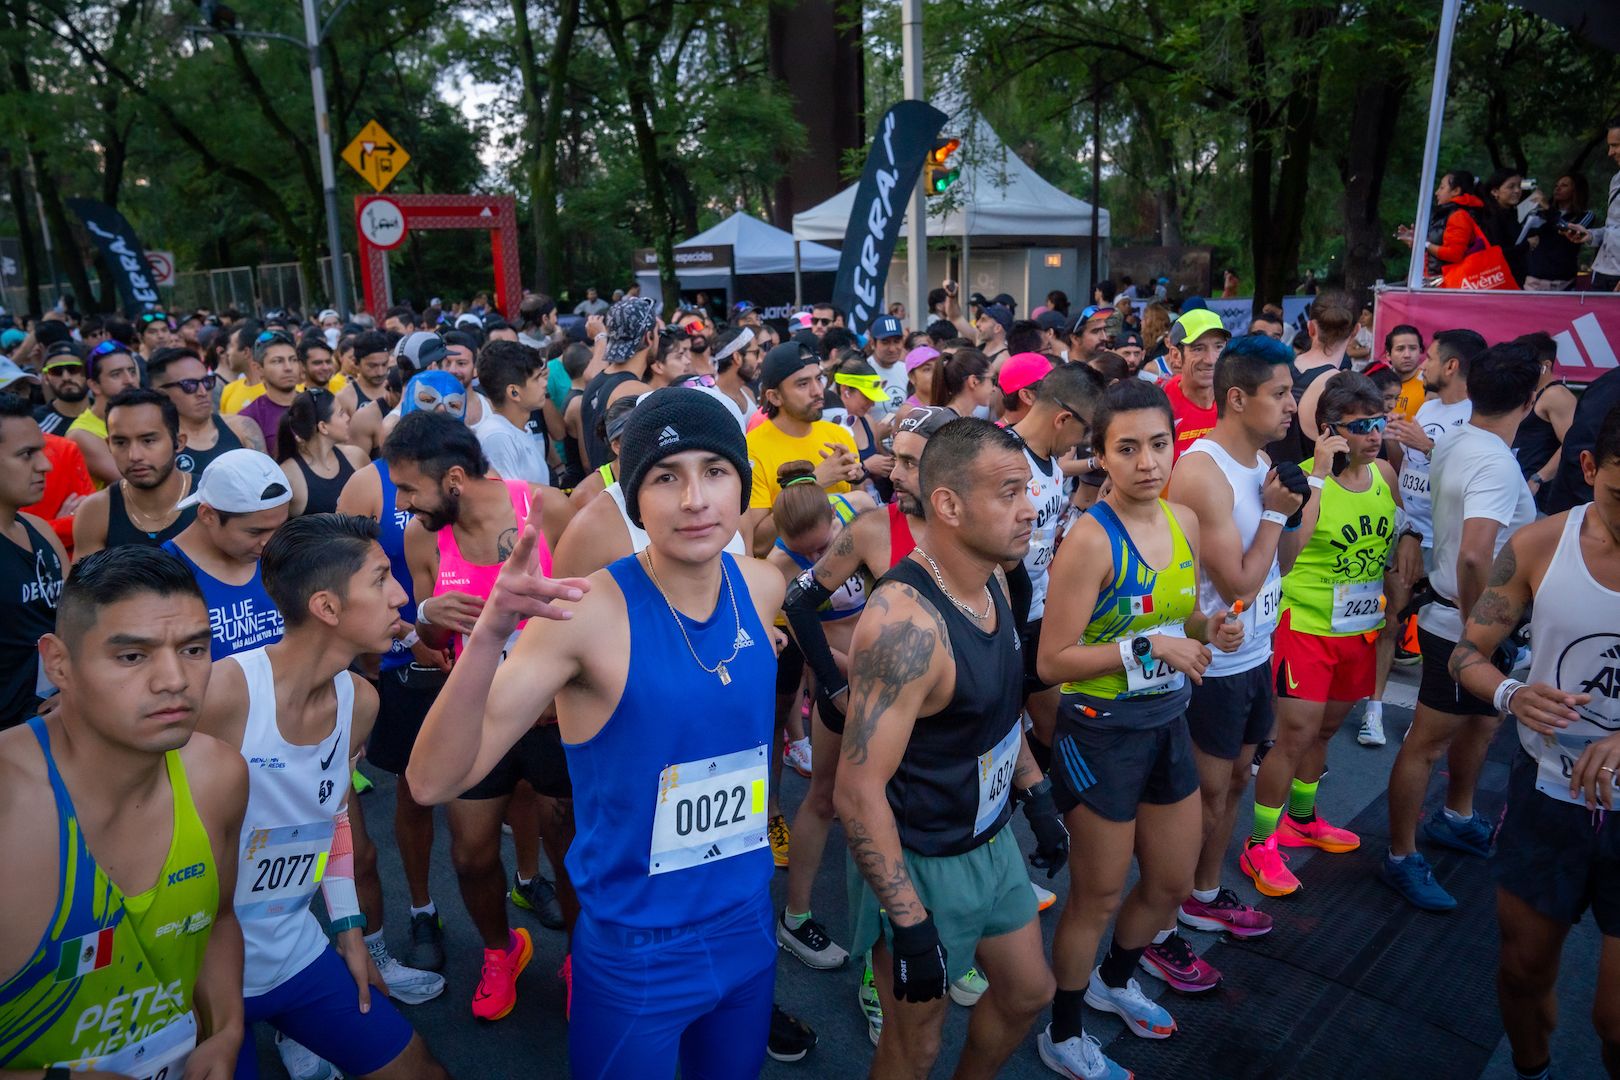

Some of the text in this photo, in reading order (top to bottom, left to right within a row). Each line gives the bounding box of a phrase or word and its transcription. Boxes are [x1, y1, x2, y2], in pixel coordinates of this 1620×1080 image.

[1461, 271, 1504, 290] Avène
[1402, 473, 1426, 494] 0334
[209, 598, 254, 628] BLUE
[1344, 598, 1379, 617] 2423
[212, 609, 285, 643] RUNNERS
[676, 785, 747, 837] 0022
[168, 863, 206, 887] XCEED
[251, 853, 316, 893] 2077
